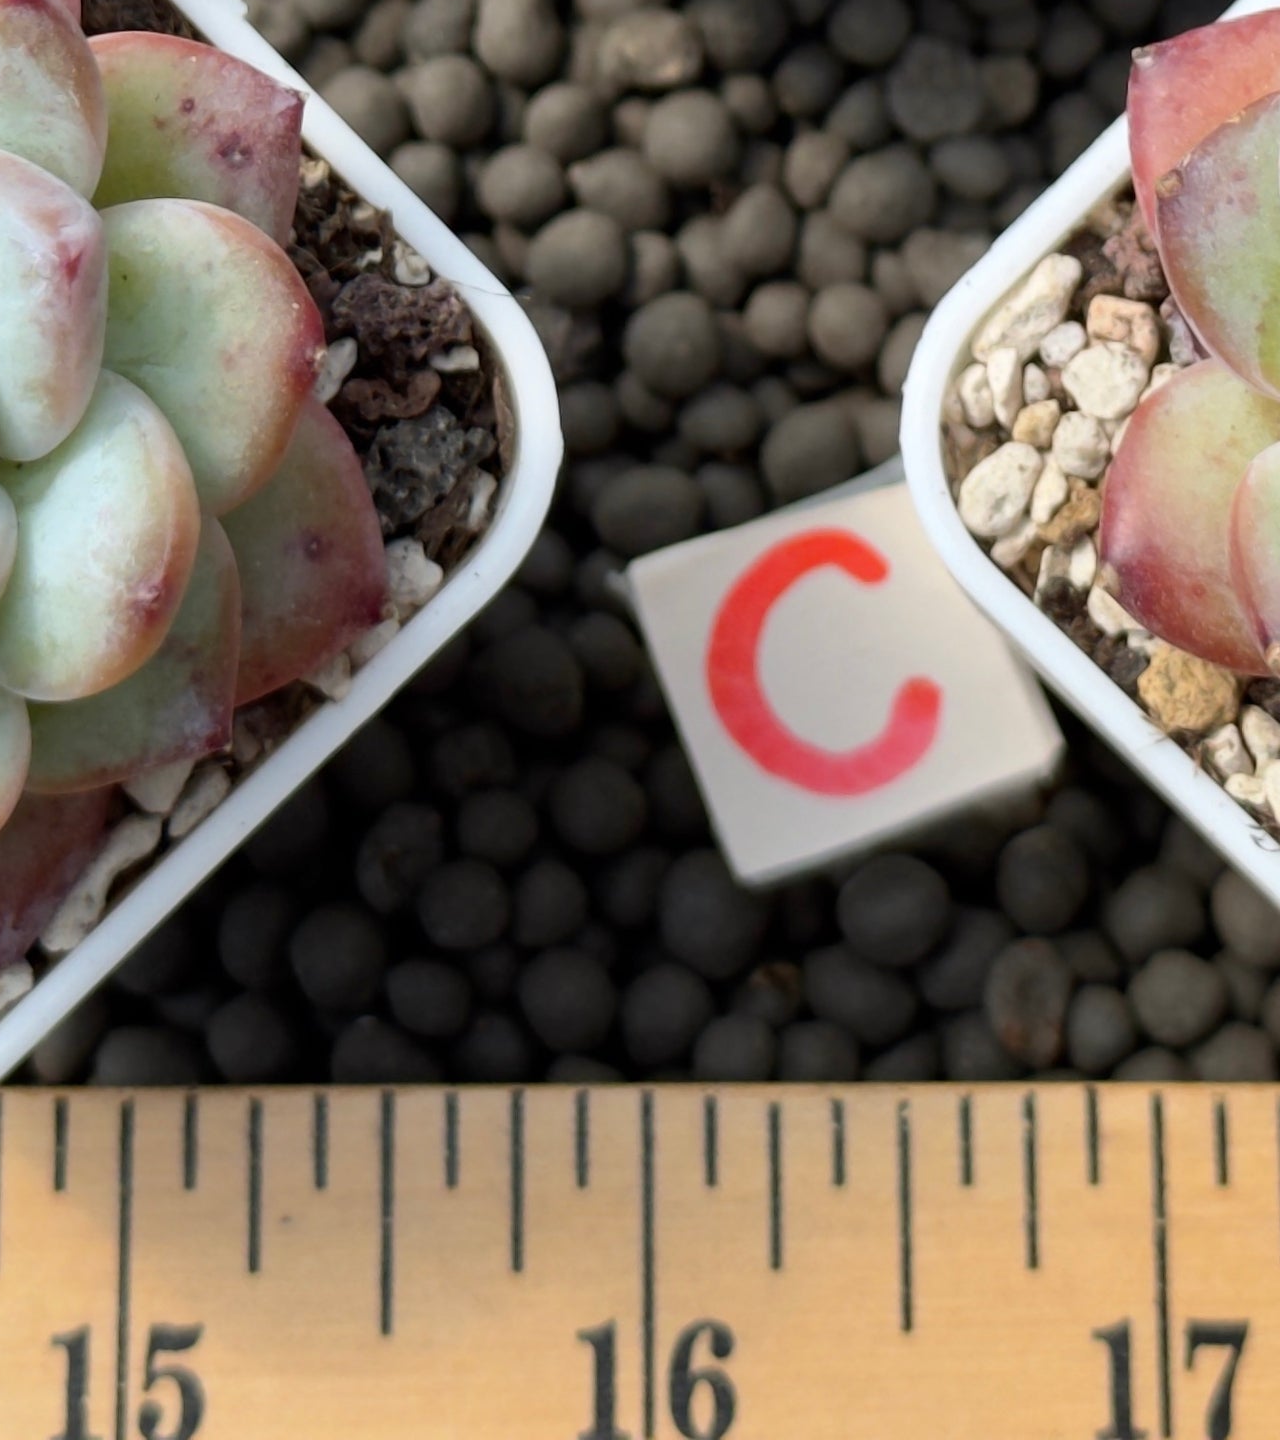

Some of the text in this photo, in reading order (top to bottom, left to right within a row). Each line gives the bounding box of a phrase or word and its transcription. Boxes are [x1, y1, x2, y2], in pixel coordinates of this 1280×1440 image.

[710, 528, 942, 796] C
[51, 1325, 205, 1440] 15
[575, 1319, 736, 1440] 16
[1093, 1321, 1249, 1440] 17
